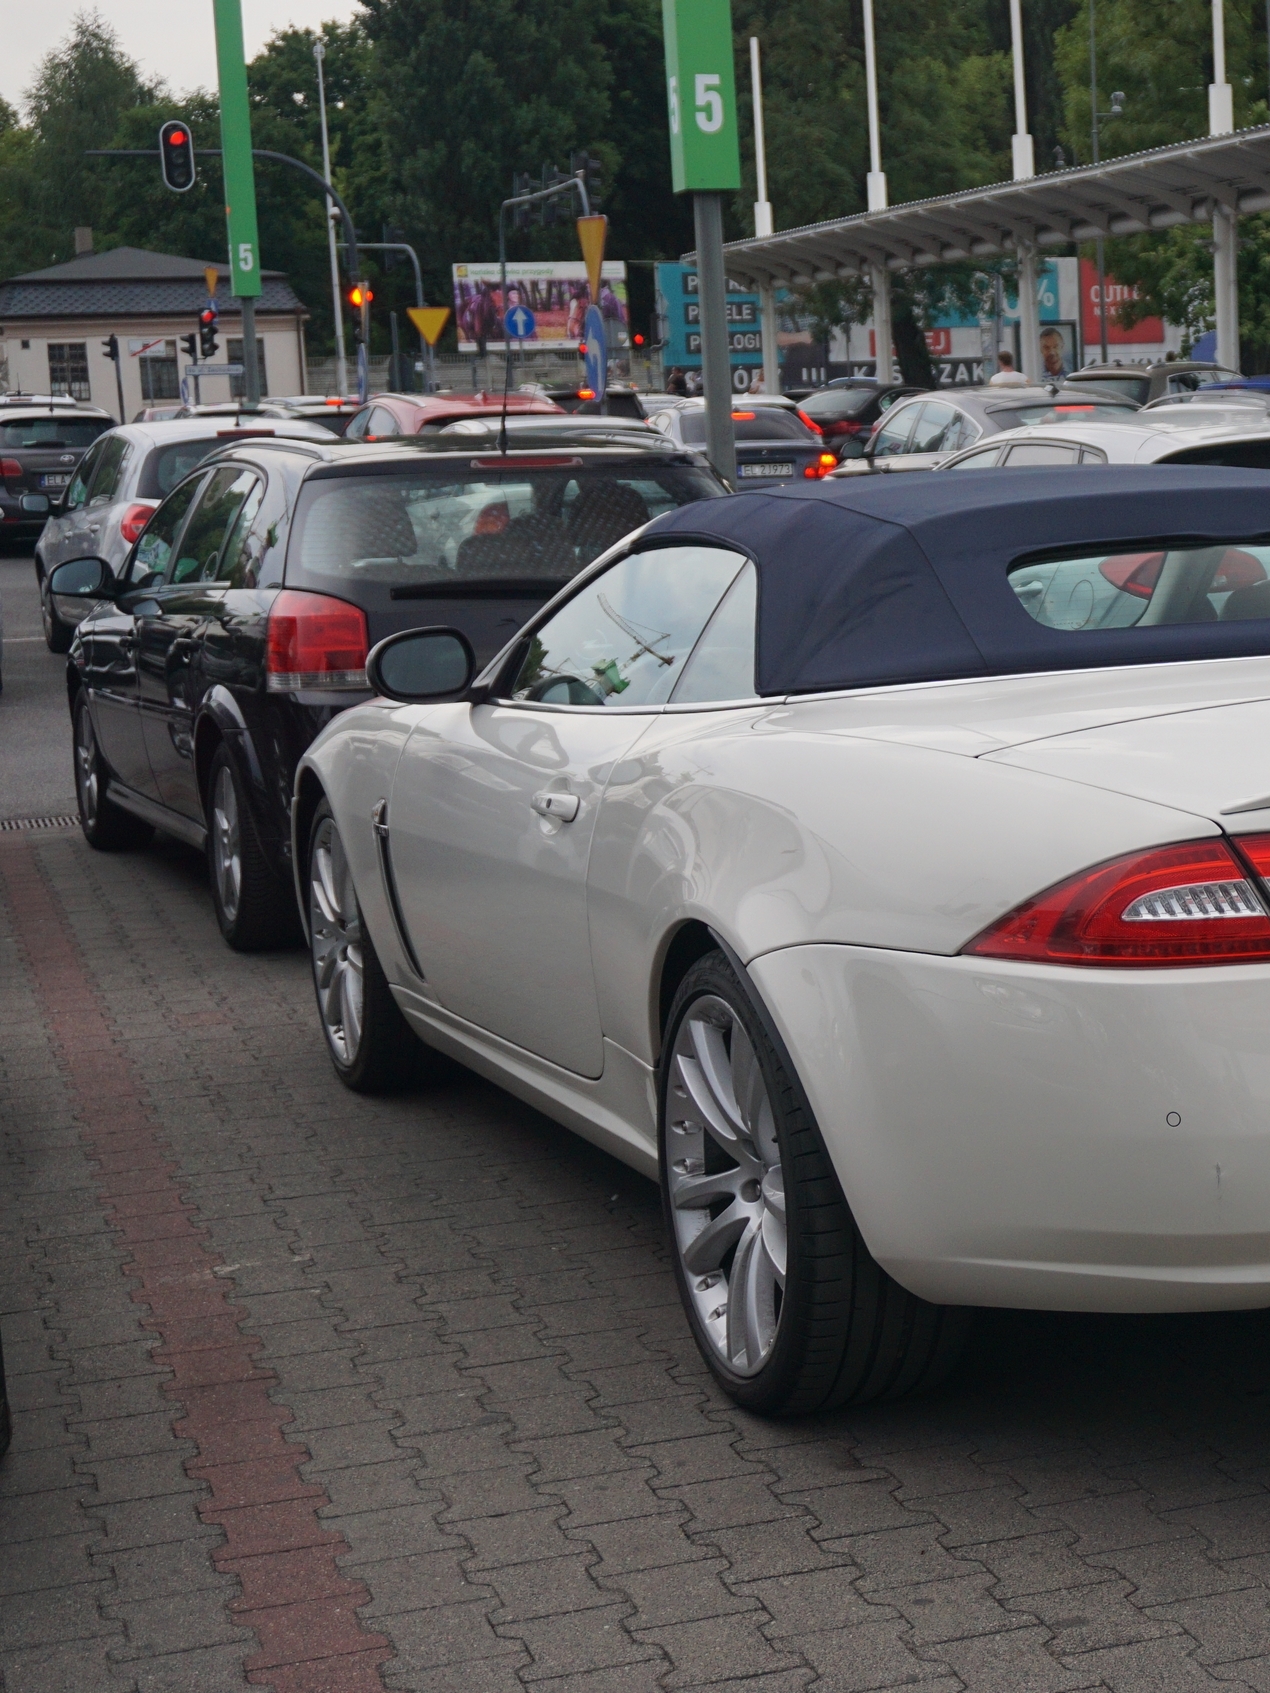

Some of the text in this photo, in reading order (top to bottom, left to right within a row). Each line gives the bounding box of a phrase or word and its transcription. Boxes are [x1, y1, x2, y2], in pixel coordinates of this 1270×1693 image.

[695, 73, 724, 133] 5
[238, 243, 254, 271] 5
[744, 465, 757, 476] EL
